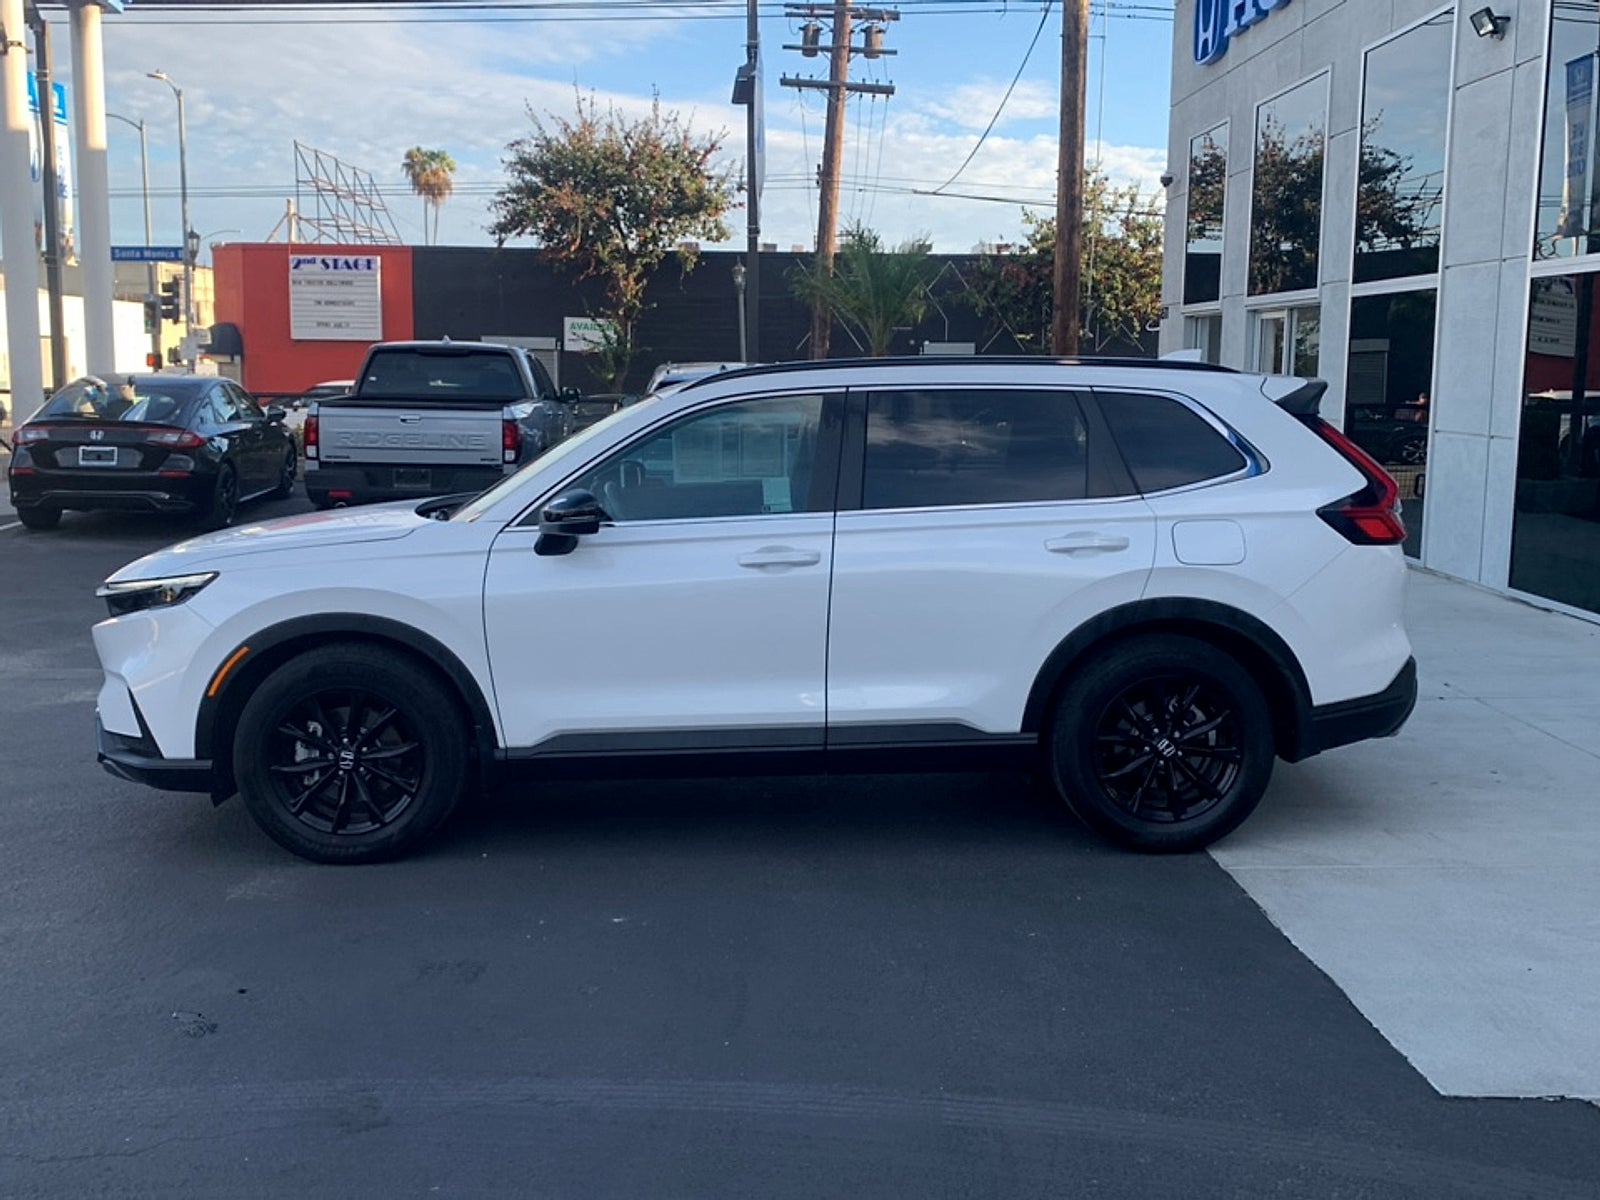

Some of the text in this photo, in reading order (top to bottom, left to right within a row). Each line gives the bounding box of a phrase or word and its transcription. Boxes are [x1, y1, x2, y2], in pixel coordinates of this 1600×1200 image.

[113, 248, 141, 259] Santa
[292, 257, 375, 271] 2nd STAGE
[336, 431, 490, 448] RIDGELINE
